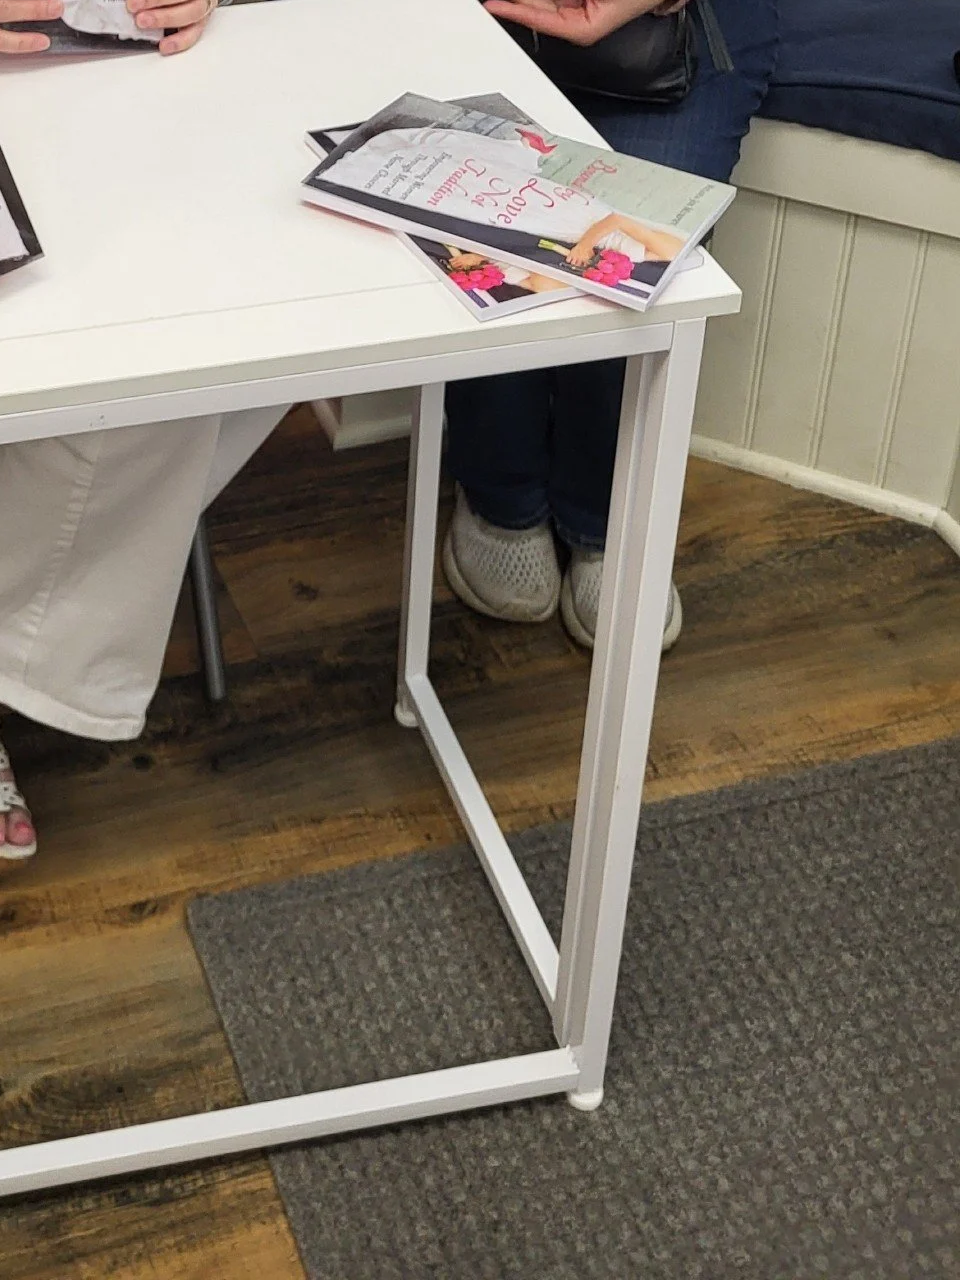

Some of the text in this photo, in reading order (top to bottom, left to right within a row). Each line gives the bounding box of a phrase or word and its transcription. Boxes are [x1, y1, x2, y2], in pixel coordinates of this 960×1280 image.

[427, 158, 487, 206] Tradition
[471, 177, 511, 208] Not
[488, 177, 555, 224] Love,
